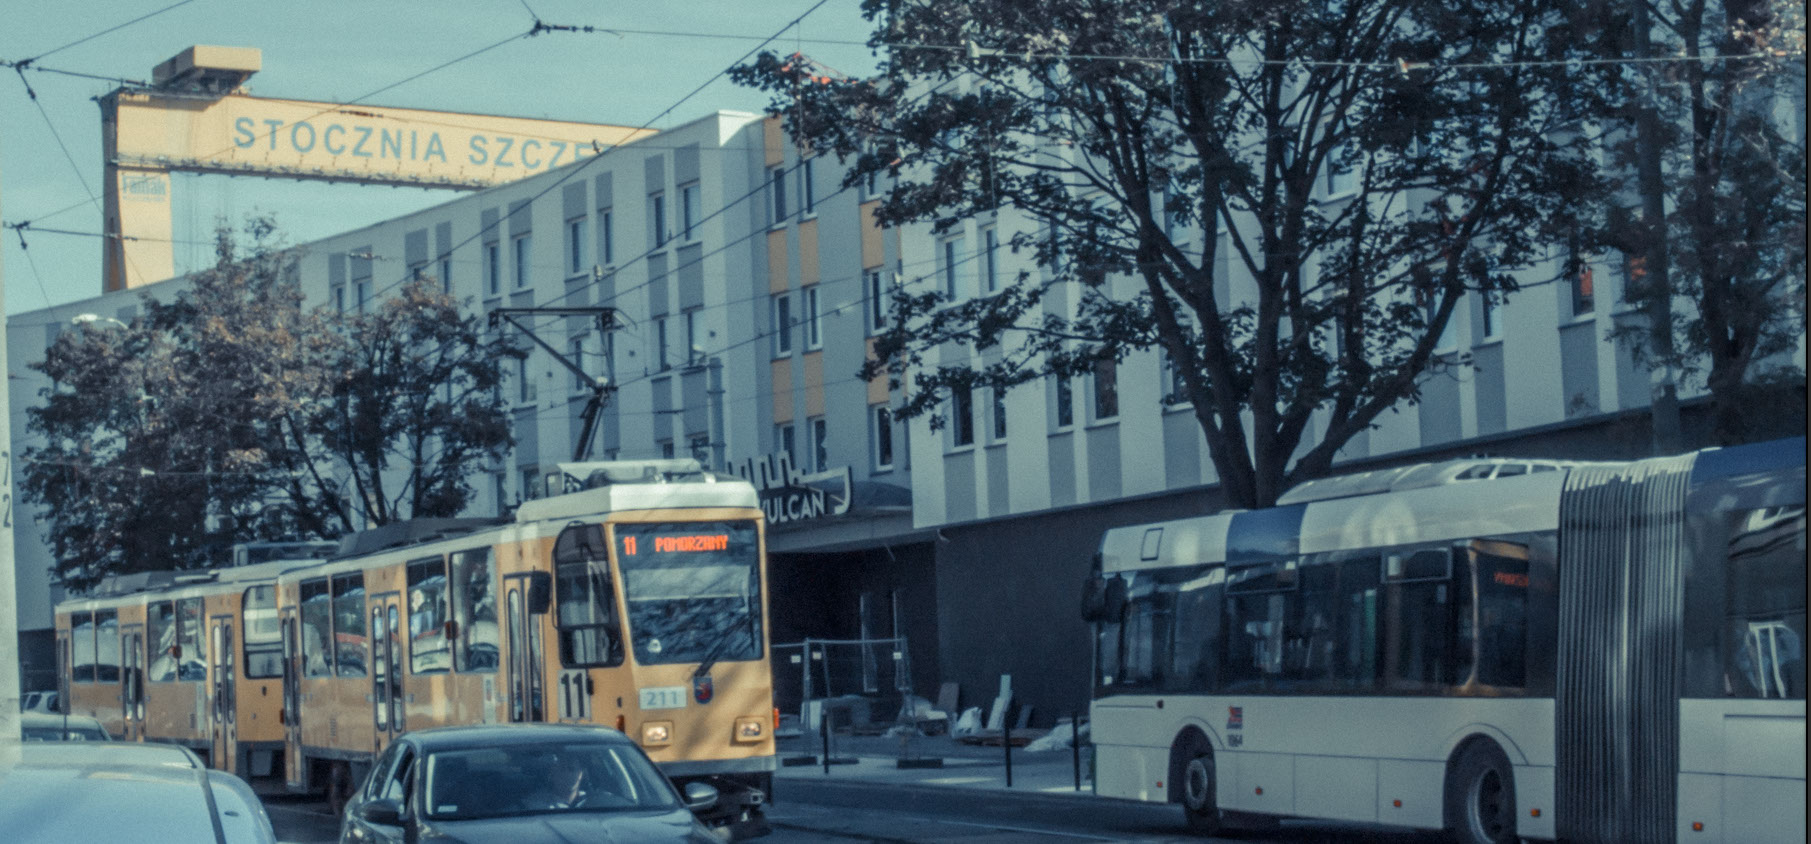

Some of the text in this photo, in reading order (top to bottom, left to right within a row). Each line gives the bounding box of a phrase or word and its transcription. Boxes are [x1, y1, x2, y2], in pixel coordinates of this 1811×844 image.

[234, 116, 612, 169] STOCZNIA SZCZE
[623, 535, 728, 556] 11 POMORZANY
[561, 673, 585, 718] 11
[646, 691, 677, 706] 211
